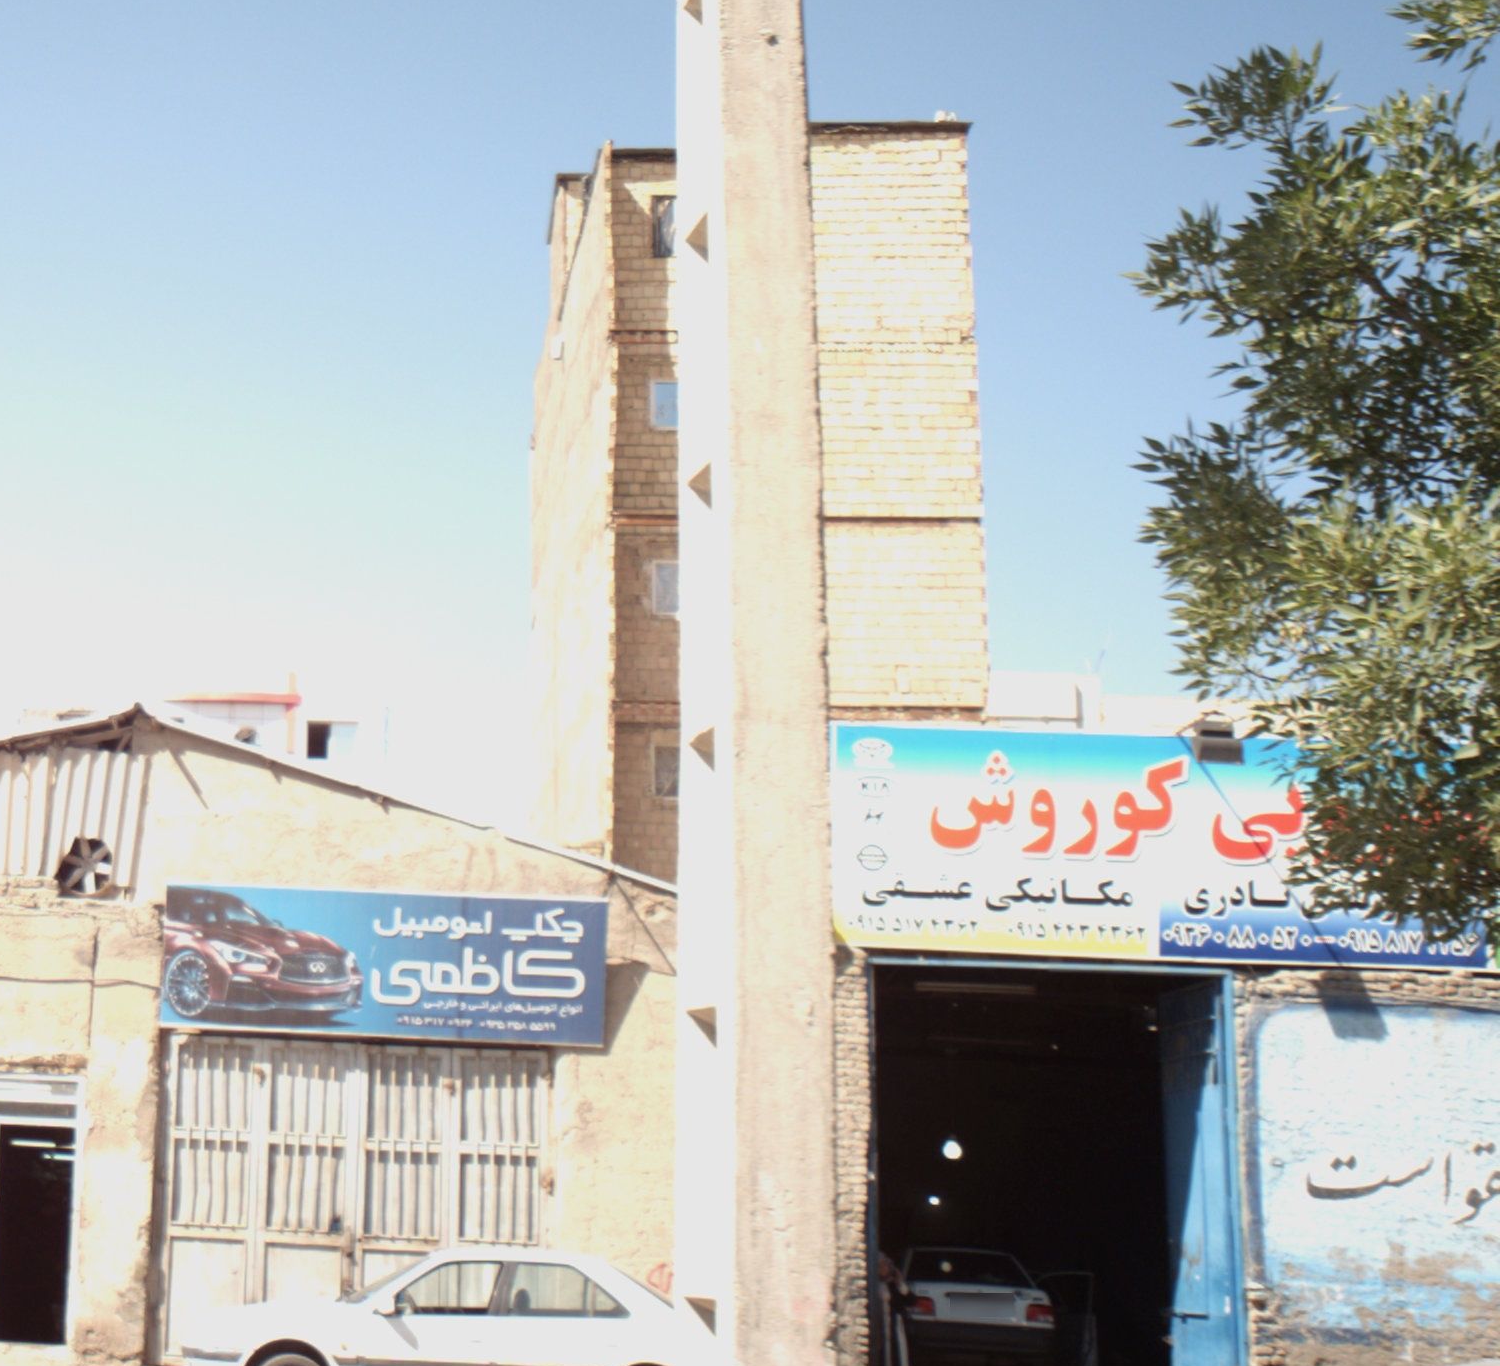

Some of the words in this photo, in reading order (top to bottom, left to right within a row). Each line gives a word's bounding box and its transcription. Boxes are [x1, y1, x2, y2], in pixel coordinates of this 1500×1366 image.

[930, 755, 1185, 856] کوروش
[862, 873, 972, 907] عشقی
[985, 877, 1133, 912] مکانیکی
[370, 946, 586, 1006] کاظمی
